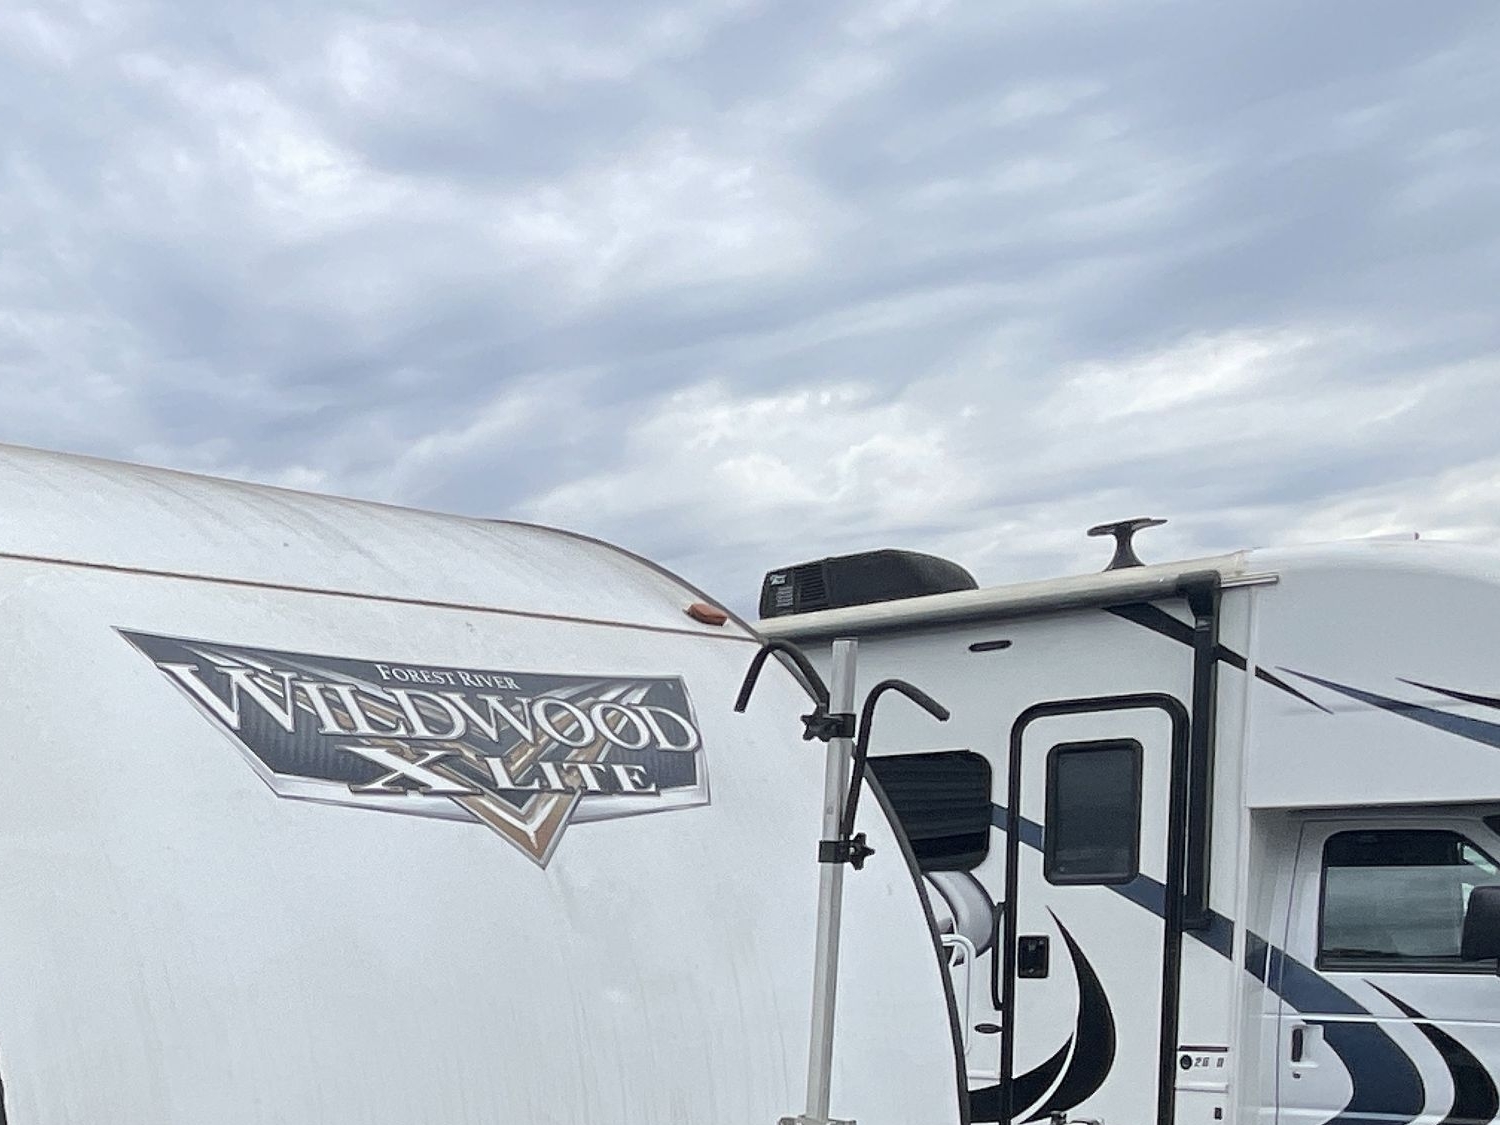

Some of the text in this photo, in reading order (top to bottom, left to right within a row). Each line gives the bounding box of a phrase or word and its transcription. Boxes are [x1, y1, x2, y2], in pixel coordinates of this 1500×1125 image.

[375, 664, 521, 690] FOREST RIVER
[156, 662, 700, 751] WILDWOOD
